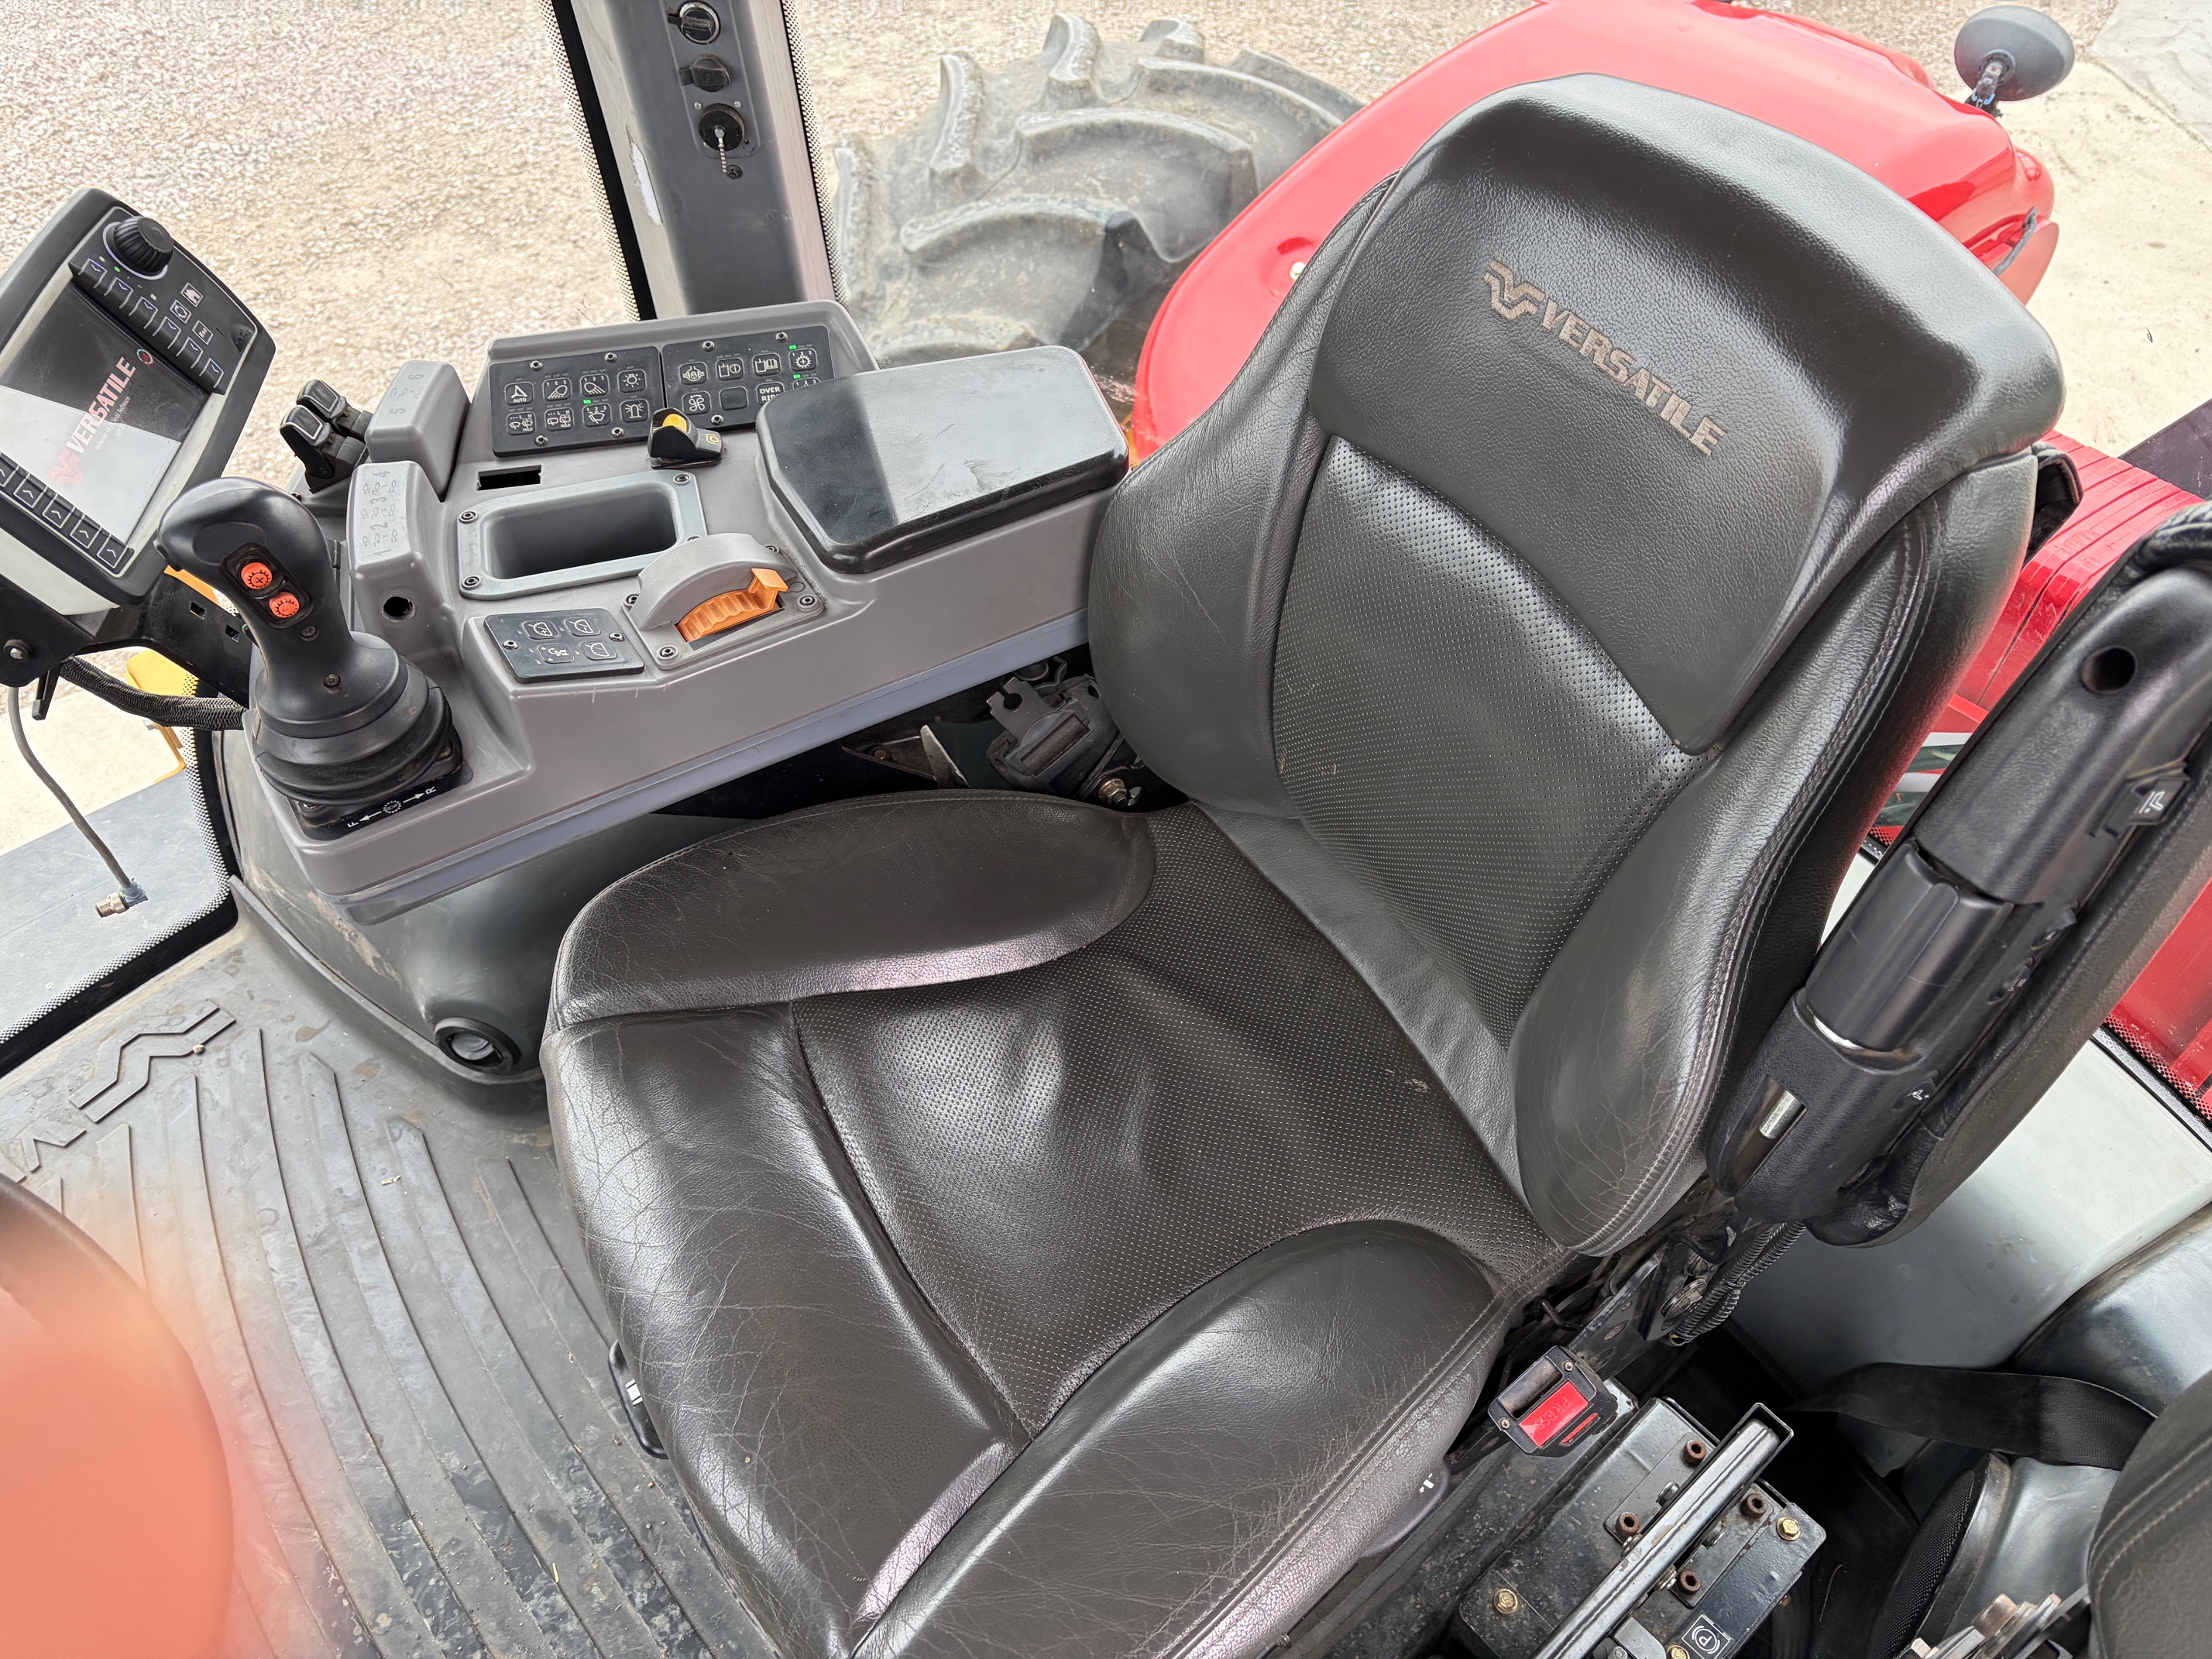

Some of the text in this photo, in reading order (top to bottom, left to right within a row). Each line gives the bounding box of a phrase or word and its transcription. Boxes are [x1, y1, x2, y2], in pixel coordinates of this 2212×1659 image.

[198, 327, 208, 338] Esc
[1543, 299, 1727, 458] VERSATILE
[66, 356, 136, 454] VERSATILE
[370, 522, 388, 531] 2
[425, 786, 437, 795] R
[1534, 1396, 1573, 1429] PRESS
